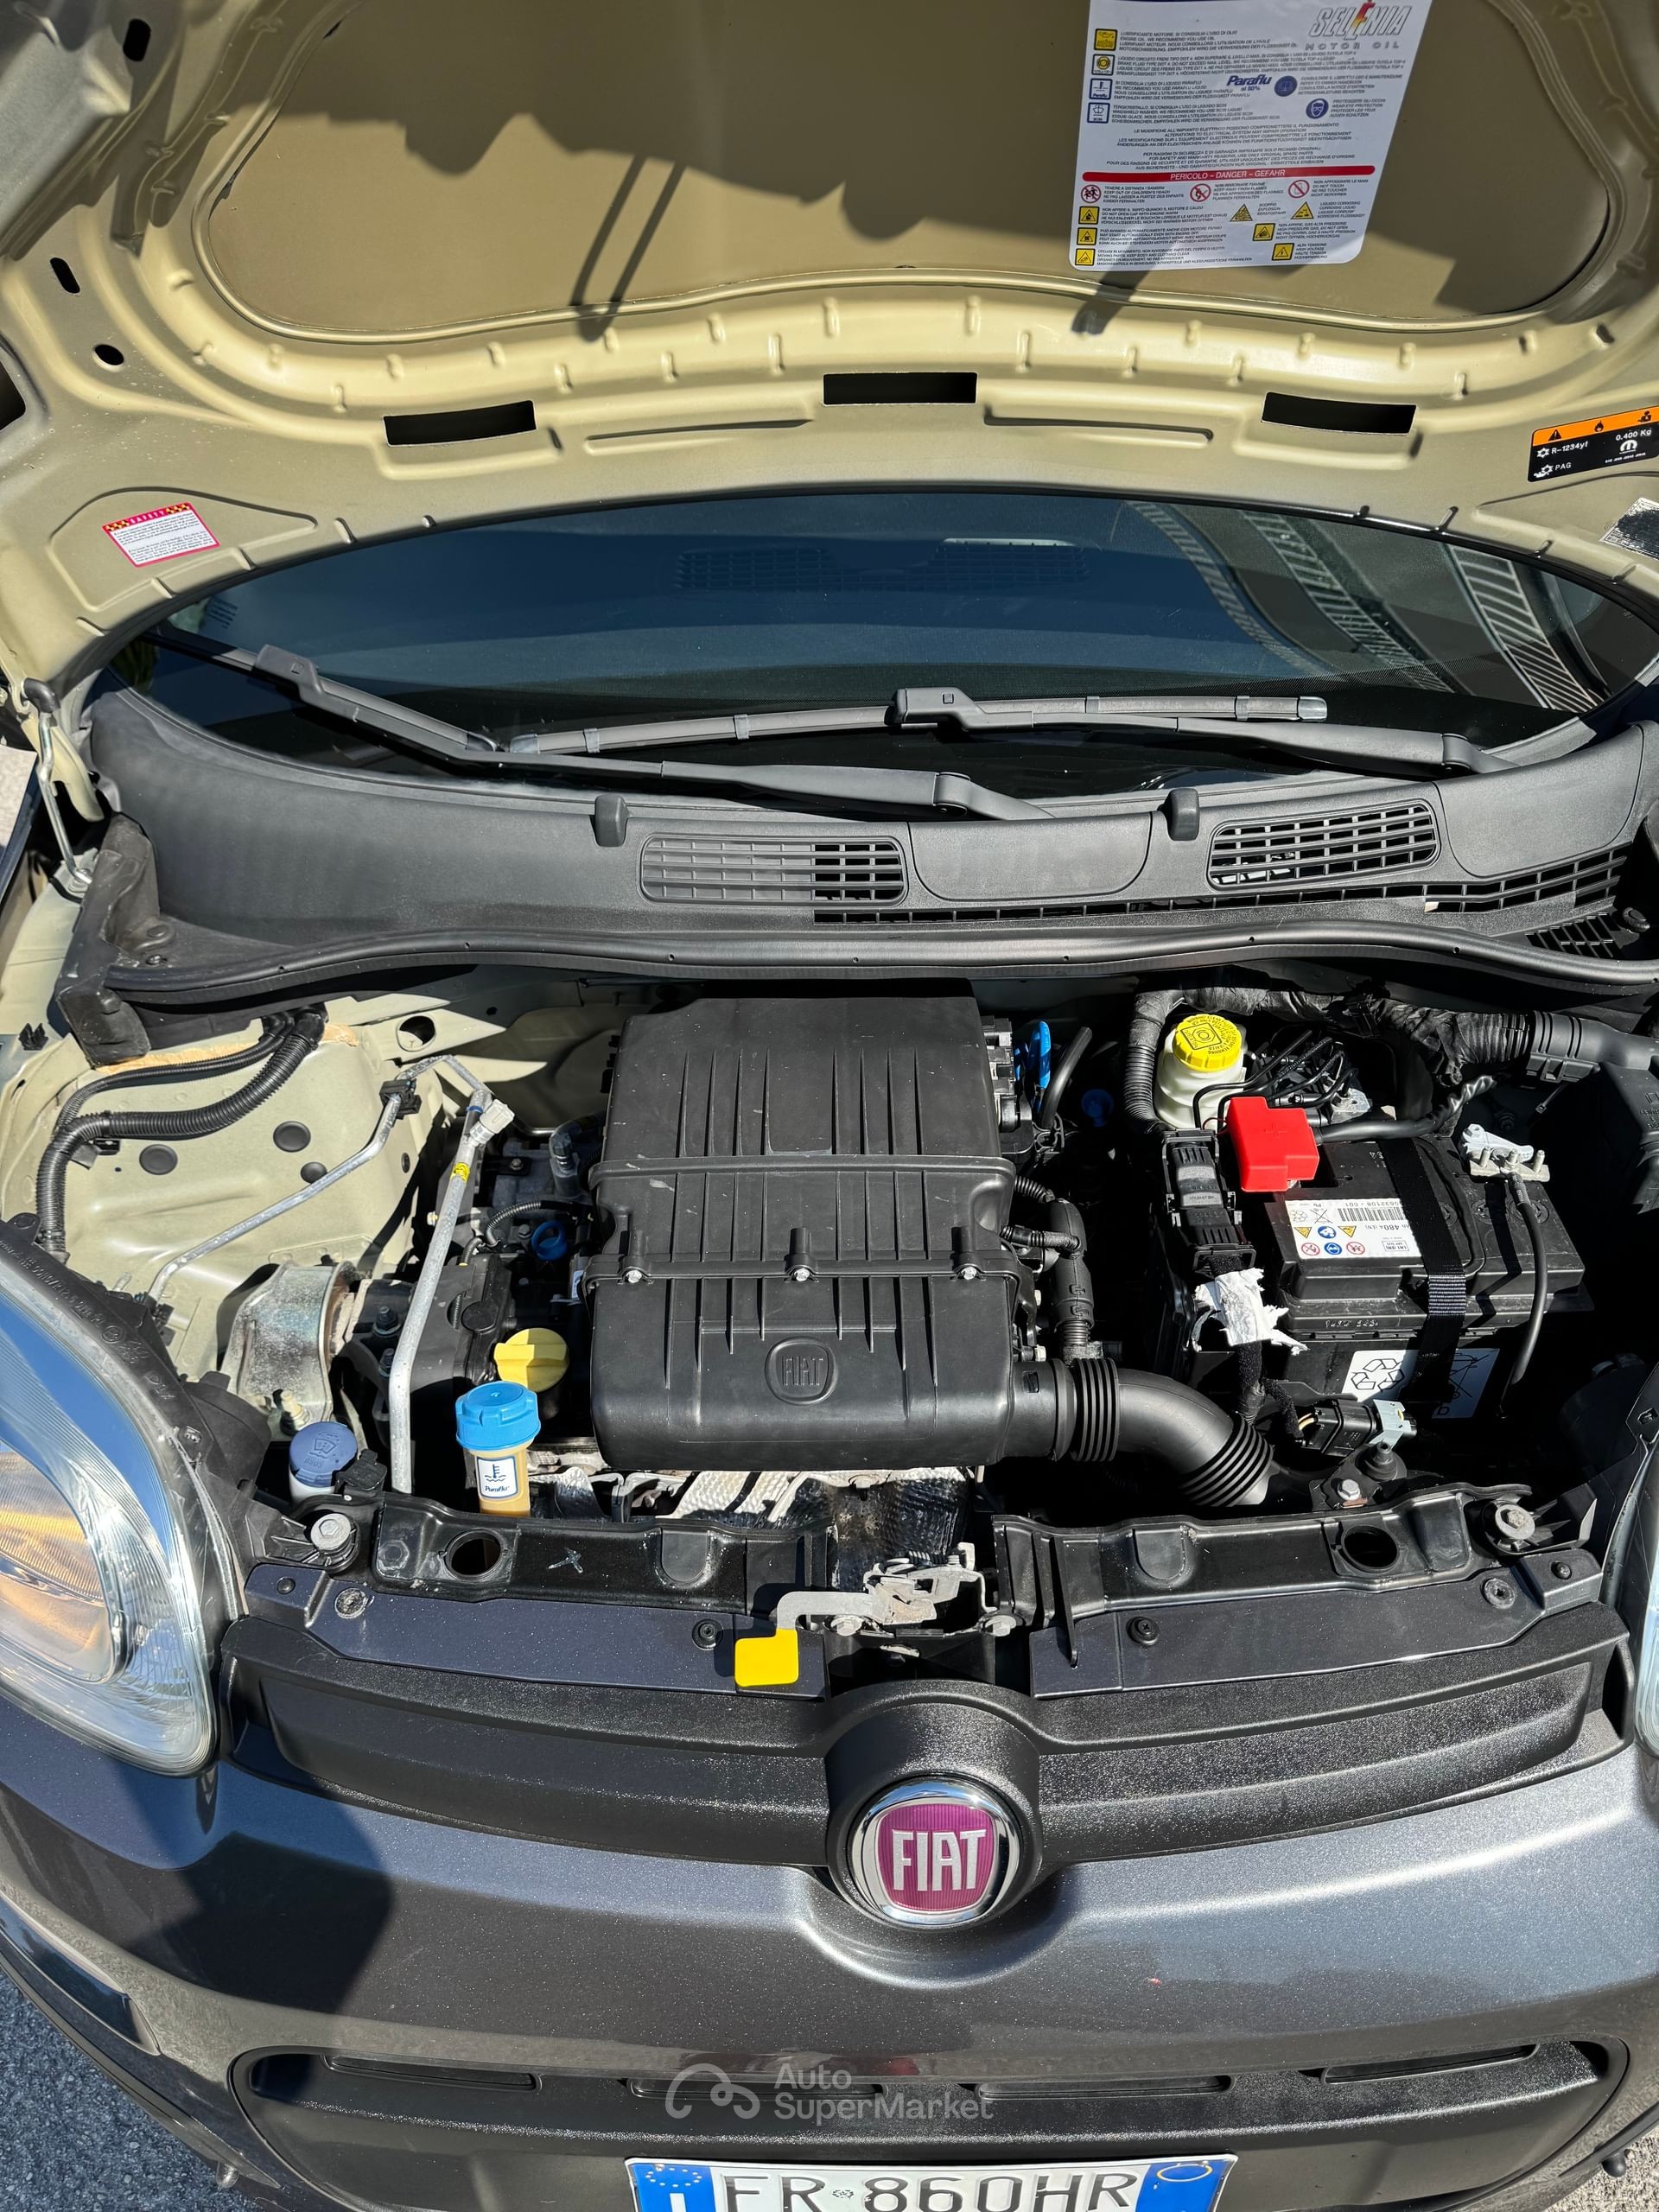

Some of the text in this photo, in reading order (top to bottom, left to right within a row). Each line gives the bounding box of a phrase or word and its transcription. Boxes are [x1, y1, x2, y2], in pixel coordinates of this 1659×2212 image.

[1308, 1, 1413, 41] SELENIA
[1305, 43, 1361, 51] MOTOR
[1227, 74, 1272, 86] Paraflu
[1615, 430, 1638, 441] 0.400
[1554, 461, 1572, 471] PAG
[130, 510, 165, 524] SAFETY
[782, 1356, 823, 1386] FIAT
[891, 1829, 987, 1892] FIAT
